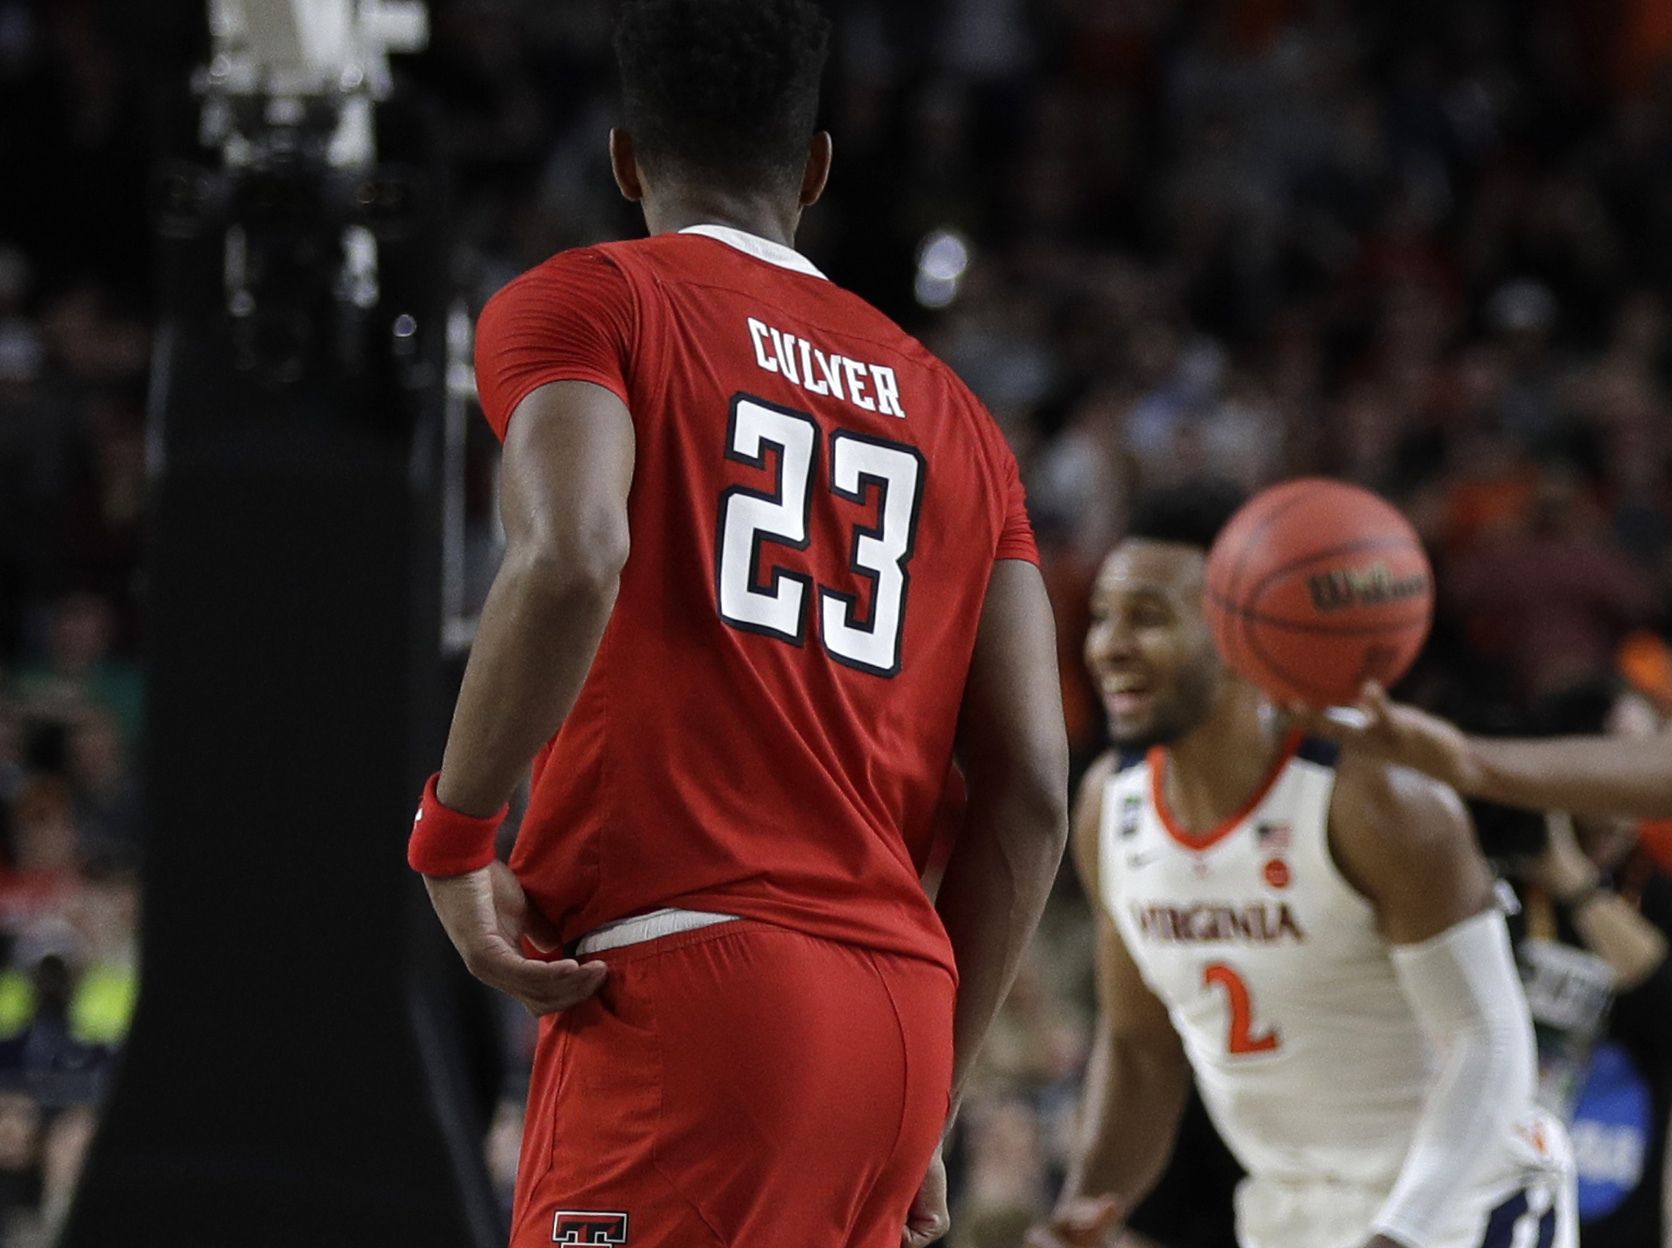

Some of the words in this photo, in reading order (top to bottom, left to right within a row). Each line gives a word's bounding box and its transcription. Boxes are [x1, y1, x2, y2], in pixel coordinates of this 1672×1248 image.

[748, 316, 906, 419] CULVER
[716, 391, 927, 678] 23
[1140, 902, 1306, 945] VIRGINIA
[1203, 962, 1282, 1055] 2
